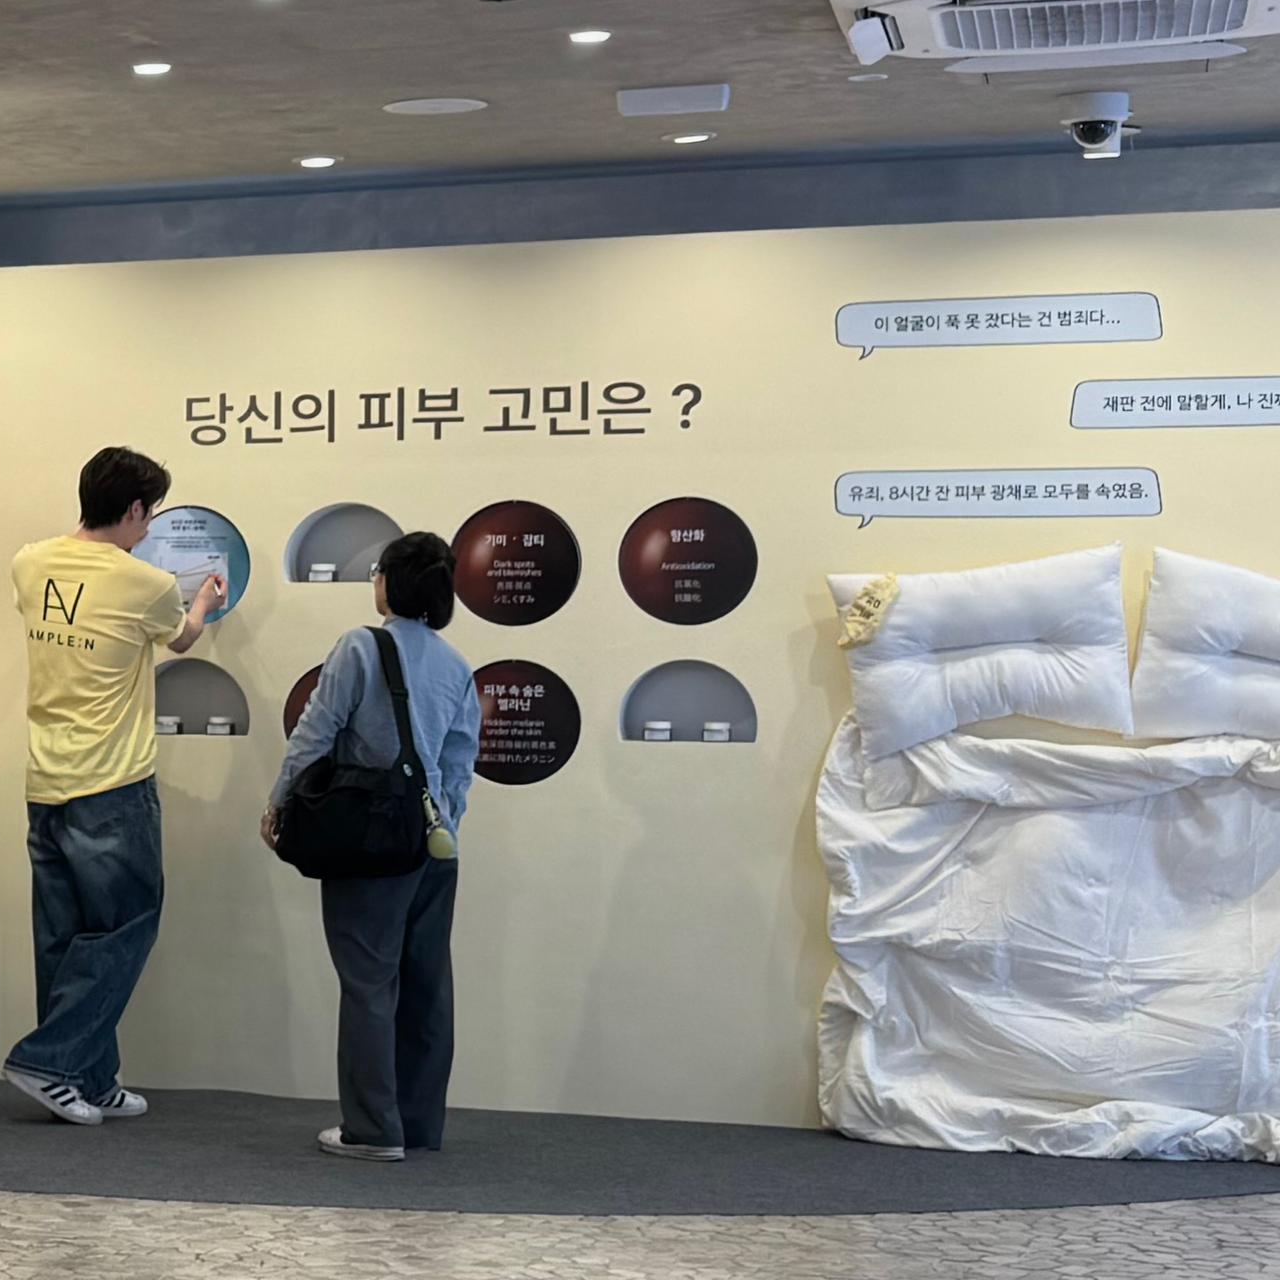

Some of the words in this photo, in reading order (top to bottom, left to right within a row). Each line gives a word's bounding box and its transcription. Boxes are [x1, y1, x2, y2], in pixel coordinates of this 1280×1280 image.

[874, 316, 889, 333] 이
[894, 314, 941, 332] 얼굴이
[944, 314, 960, 331] 푹
[964, 314, 981, 330] 못
[985, 312, 1033, 330] 잤다는
[1038, 312, 1052, 327] 건
[1056, 310, 1121, 327] 범죄다...
[1103, 394, 1135, 412] 재판
[1139, 394, 1172, 412] 전에
[1177, 393, 1231, 412] 말할게,
[1236, 393, 1254, 410] 나
[184, 389, 336, 446] 당신의
[357, 386, 465, 442] 피부
[483, 381, 652, 437] 고민은
[671, 383, 703, 429] ?
[848, 485, 884, 502] 유죄,
[888, 485, 930, 501] 8시간
[934, 484, 949, 500] 잔
[954, 483, 986, 501] 피부
[991, 482, 1038, 500] 광채로
[1042, 482, 1090, 500] 모두를
[1095, 481, 1149, 500] 속였음.
[484, 534, 507, 547] 기미
[523, 534, 544, 547] 잡티
[670, 528, 705, 543] 항산화
[493, 560, 512, 568] Dark
[29, 629, 95, 651] AMPLE:N
[483, 684, 506, 697] 피부
[497, 698, 531, 711] 멜라닌
